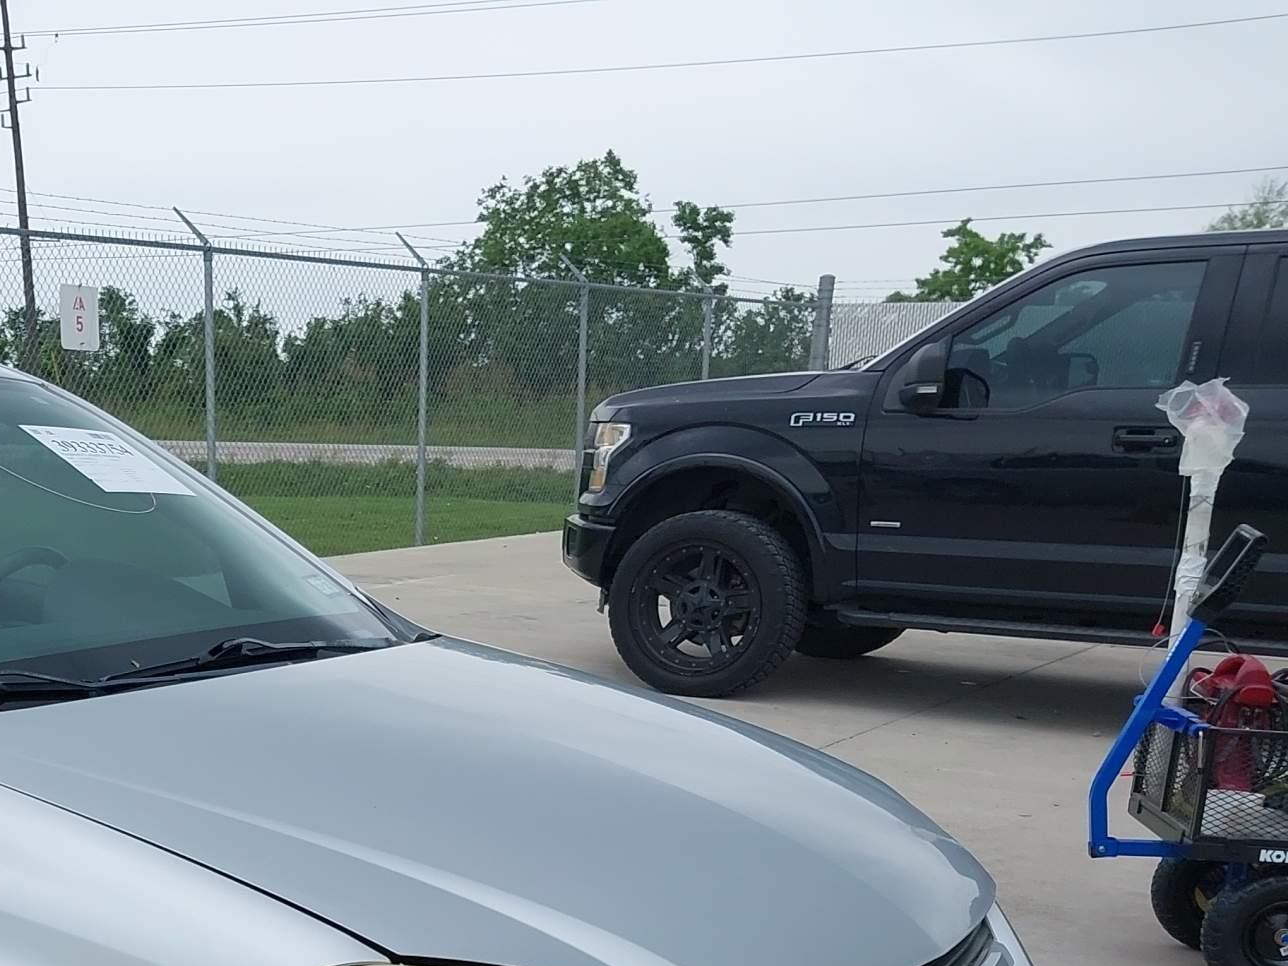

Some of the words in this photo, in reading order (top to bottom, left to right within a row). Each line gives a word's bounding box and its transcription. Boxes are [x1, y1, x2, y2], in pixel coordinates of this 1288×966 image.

[76, 315, 84, 332] 5
[51, 439, 135, 457] 39333754
[1259, 848, 1288, 864] KO
